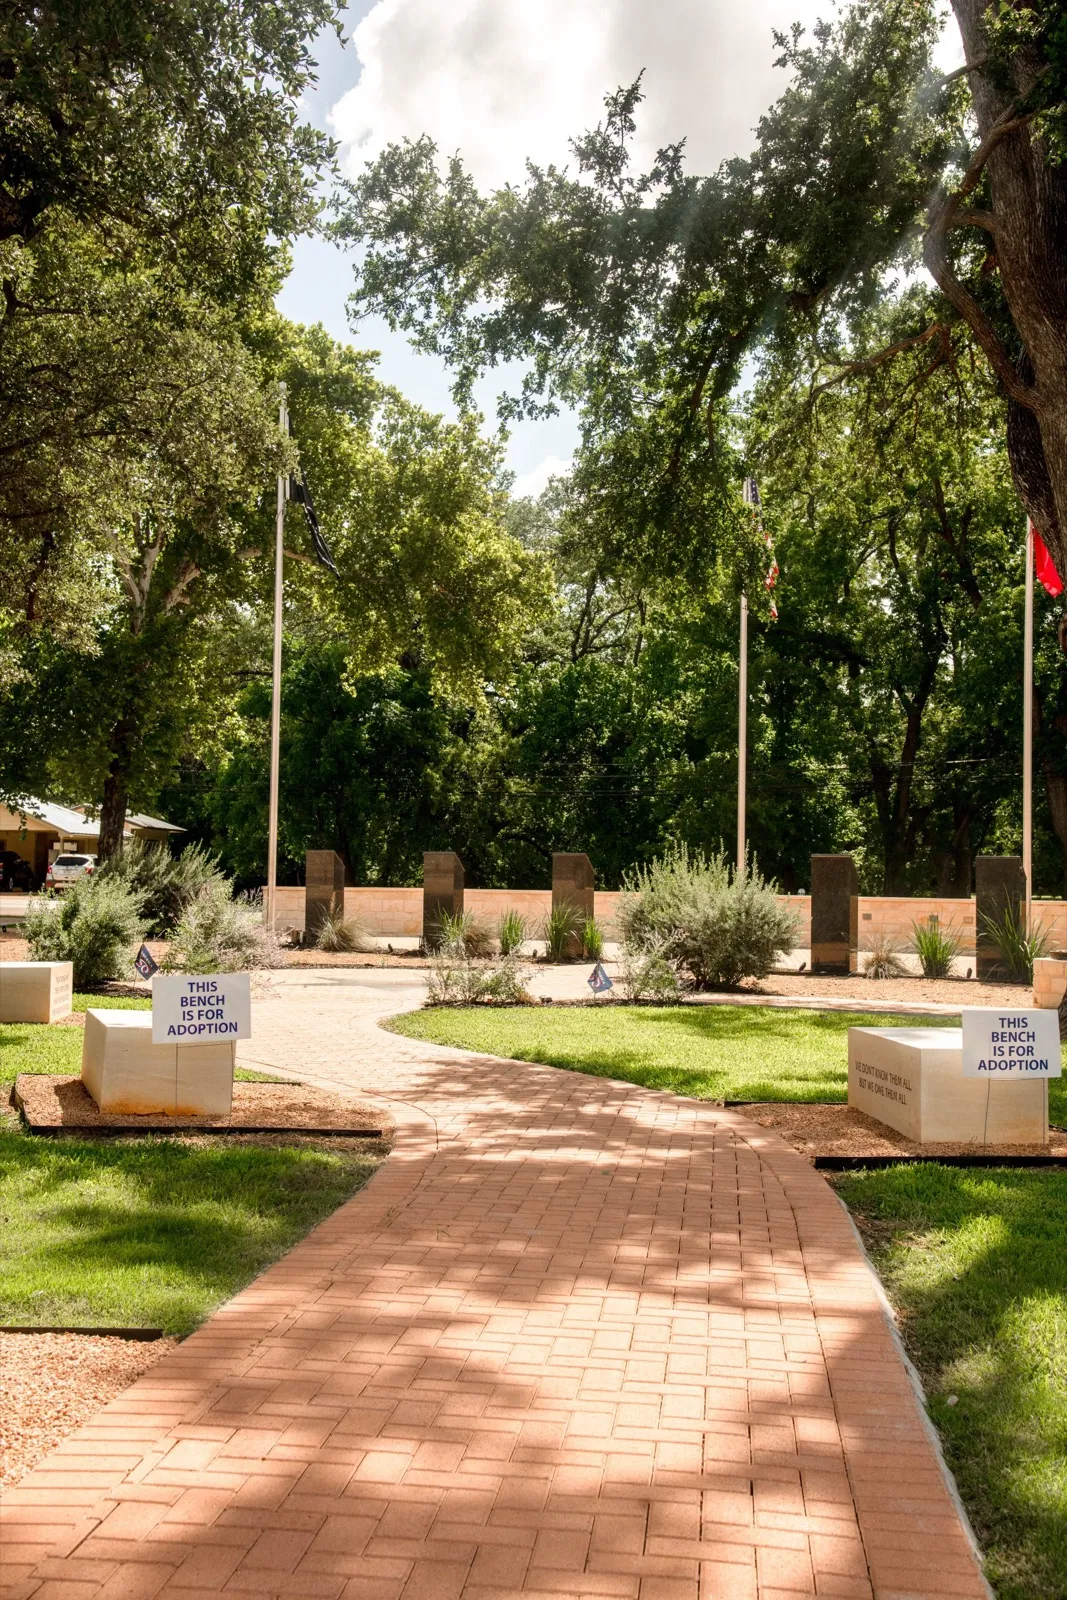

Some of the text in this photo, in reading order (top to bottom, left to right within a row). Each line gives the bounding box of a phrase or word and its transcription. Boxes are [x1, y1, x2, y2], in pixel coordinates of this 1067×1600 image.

[187, 981, 218, 993] THIS
[180, 995, 225, 1007] BENCH
[182, 1009, 224, 1021] IS FOR
[167, 1022, 238, 1035] ADOPTION
[998, 1017, 1028, 1029] THIS
[991, 1031, 1036, 1043] BENCH
[993, 1046, 1034, 1056] IS FOR
[977, 1059, 1048, 1071] ADOPTION
[875, 1068, 888, 1082] KNOW
[889, 1072, 902, 1088] THEM
[867, 1080, 874, 1092] WE
[885, 1087, 897, 1101] THEM
